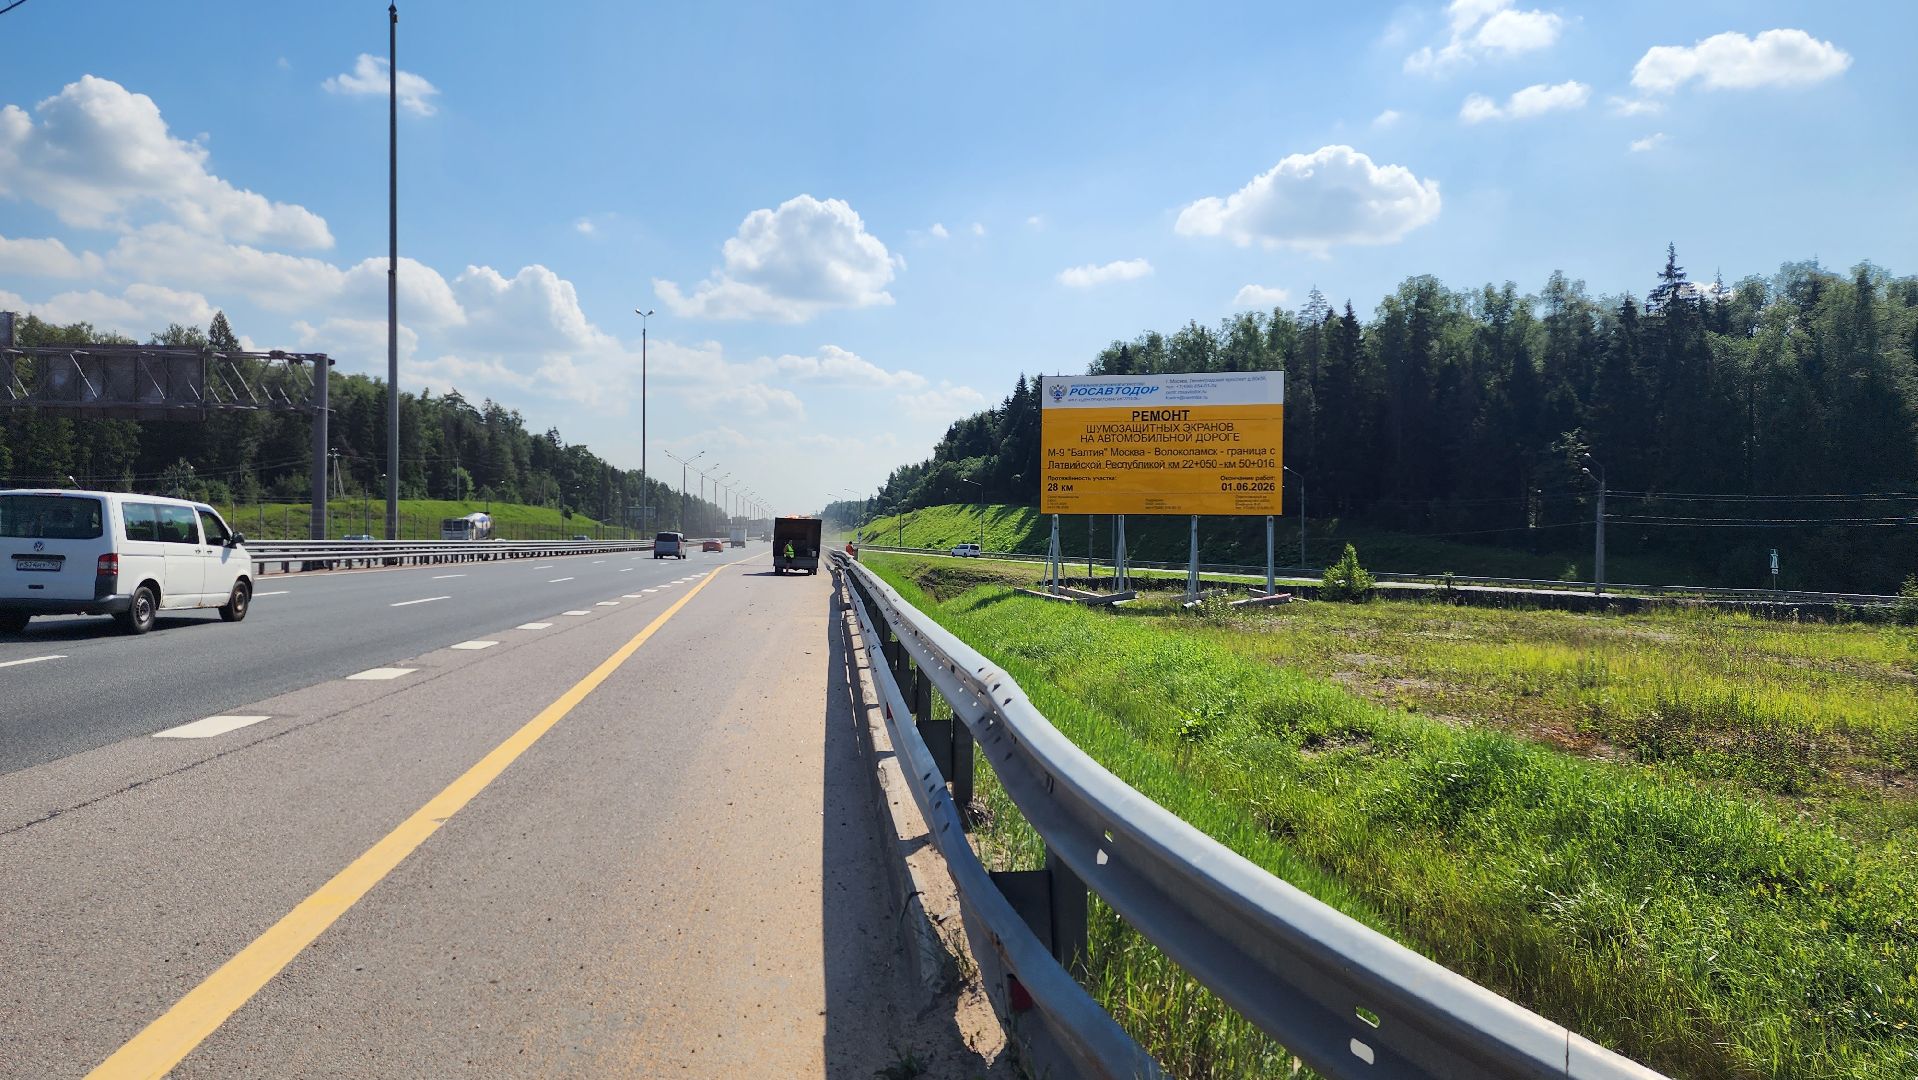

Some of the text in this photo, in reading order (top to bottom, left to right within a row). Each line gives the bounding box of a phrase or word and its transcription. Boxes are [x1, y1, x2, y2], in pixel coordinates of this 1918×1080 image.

[1069, 386, 1159, 396] РОСАВТОДОР
[1132, 410, 1190, 422] РЕМОНТ
[1086, 422, 1234, 434] ШУМОЗАЩИТНЫХ ЭКРАНОВ
[1080, 432, 1240, 443] НА АВТОМОБИЛЬНОЙ ДОРОГЕ
[1047, 448, 1065, 457] М-9
[1067, 447, 1108, 457] "Балтия"
[1110, 448, 1145, 456] Москва
[1154, 447, 1218, 456] Волоколамск
[1226, 447, 1267, 457] граница
[1270, 447, 1276, 455] с
[1047, 460, 1102, 470] Латвийской
[1105, 460, 1165, 470] Республикой
[1168, 461, 1180, 469] км
[1182, 459, 1217, 469] 22+050
[1238, 459, 1275, 468] 50+016
[1047, 483, 1073, 492] 28 км
[1221, 482, 1276, 492] 01.06.2026
